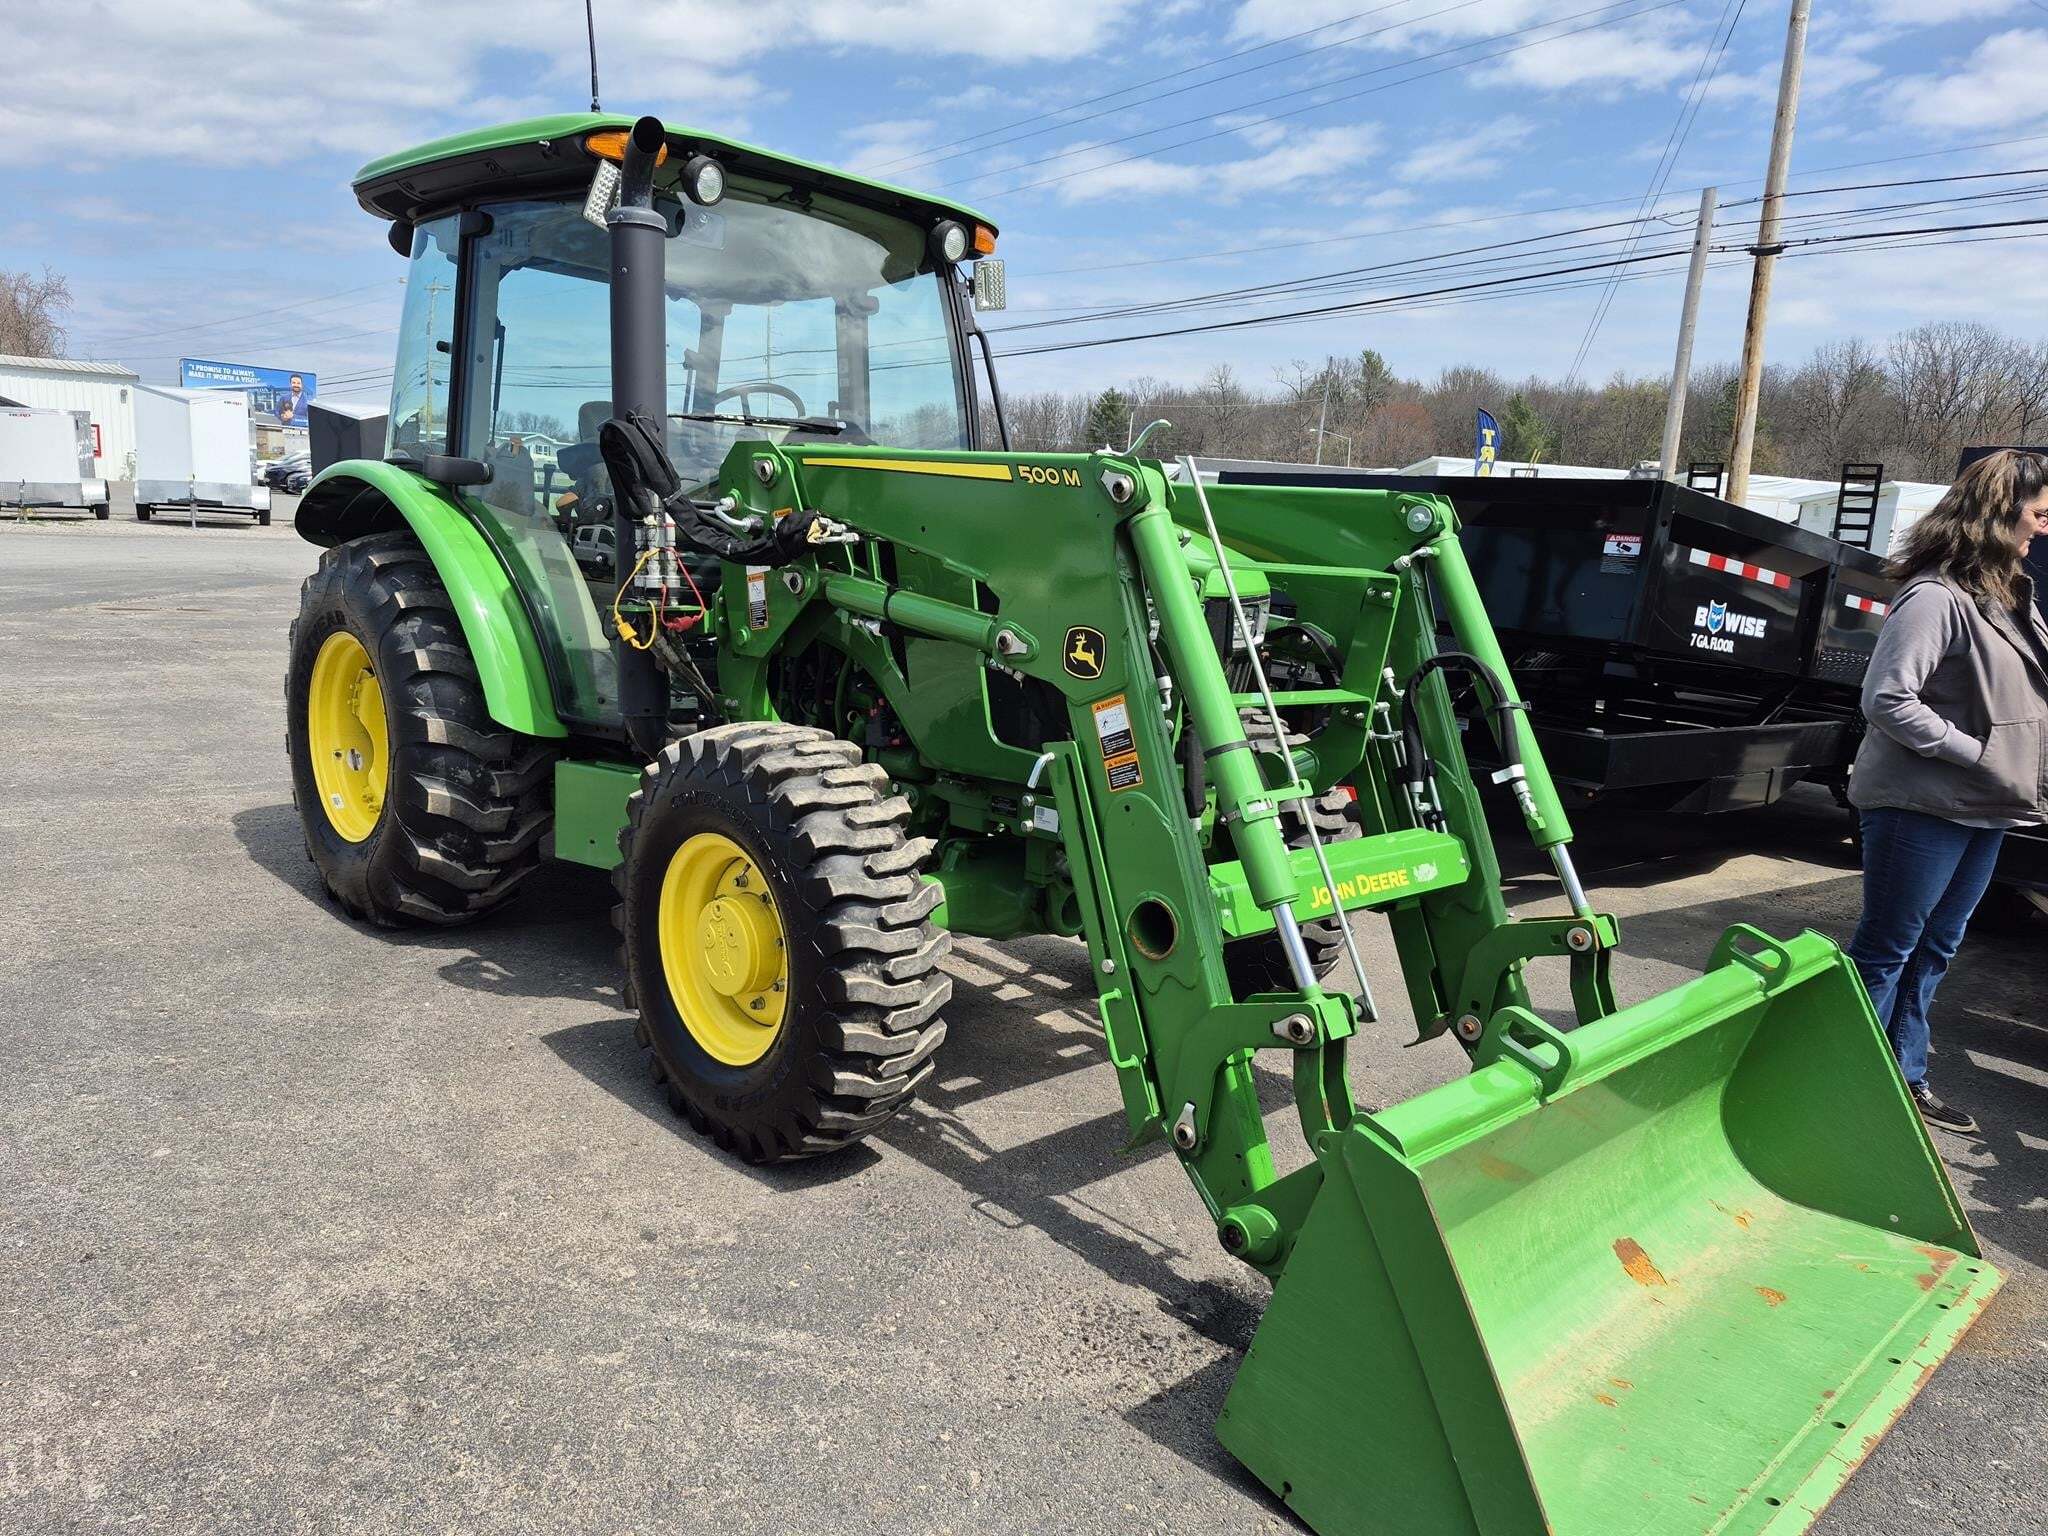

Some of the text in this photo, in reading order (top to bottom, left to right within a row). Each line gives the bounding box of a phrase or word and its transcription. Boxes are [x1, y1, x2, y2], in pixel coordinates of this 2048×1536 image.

[188, 370, 205, 379] MAKE
[213, 373, 235, 382] WORTH
[195, 364, 221, 374] PROMISE
[223, 367, 231, 375] TO
[232, 368, 255, 378] ALWAYS
[1017, 464, 1082, 487] 500 M
[1616, 535, 1641, 543] DANGER
[1690, 632, 1698, 647] 7
[1710, 636, 1734, 653] FLOOR
[1355, 868, 1410, 896] DEERE
